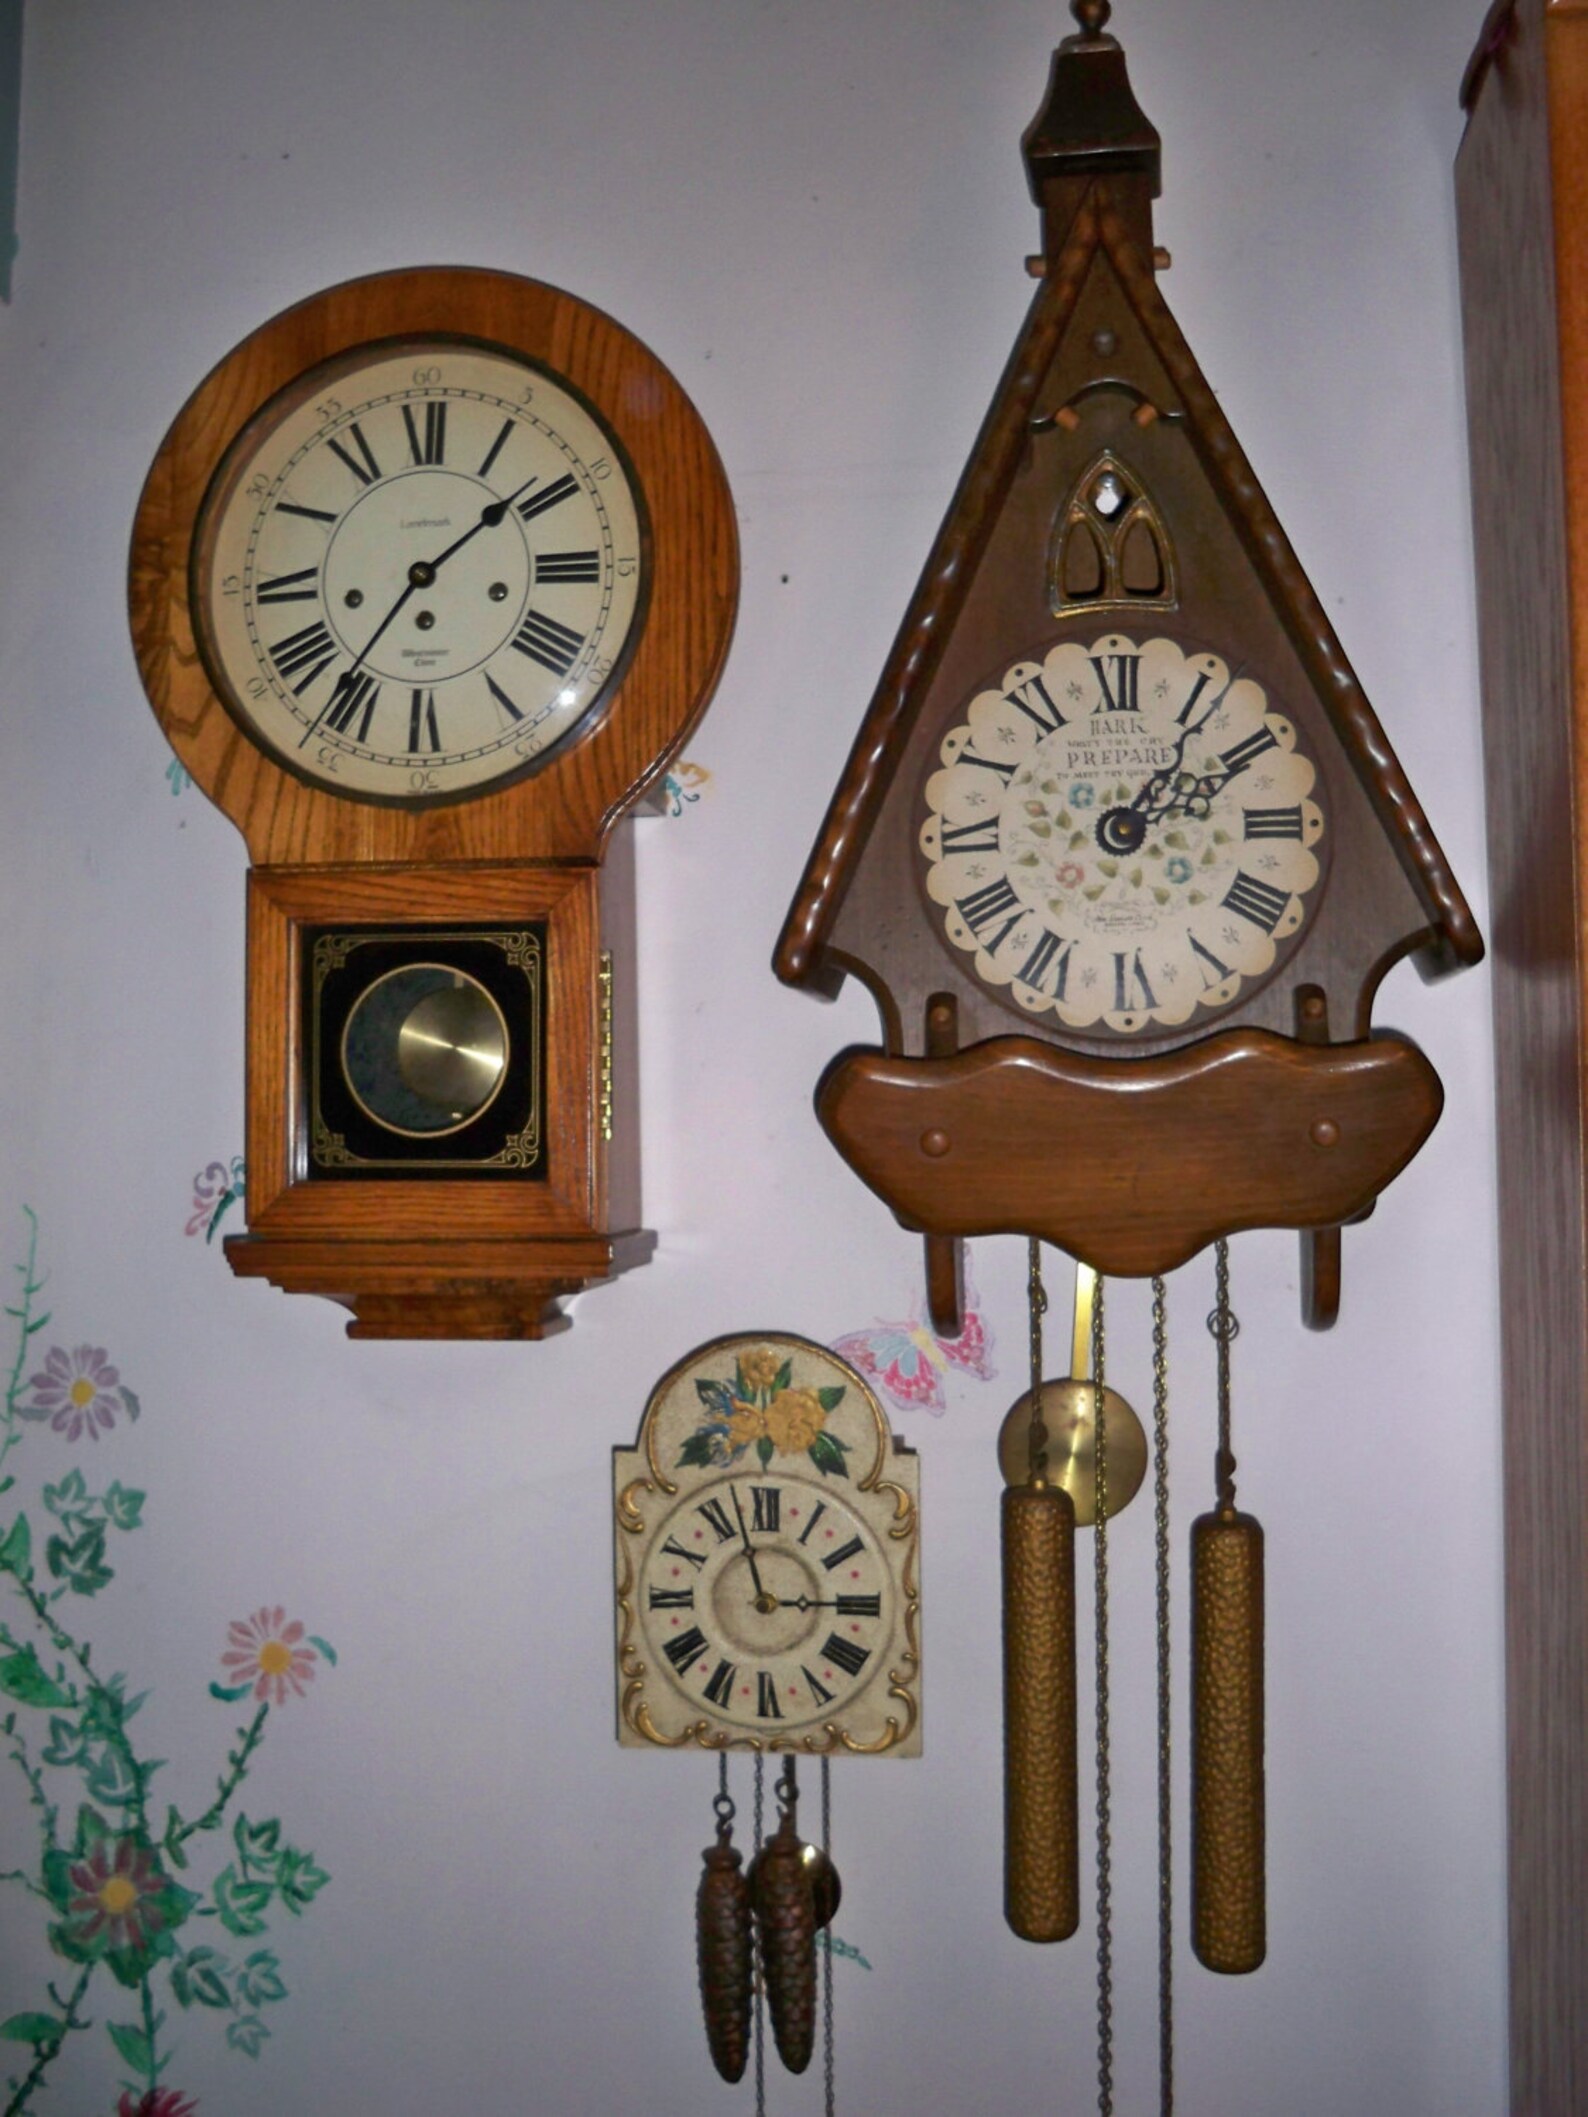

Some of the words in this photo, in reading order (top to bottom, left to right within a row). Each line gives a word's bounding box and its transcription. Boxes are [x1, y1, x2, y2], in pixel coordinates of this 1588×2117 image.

[413, 367, 441, 385] 60
[519, 387, 534, 405] 5
[316, 398, 342, 422] 55
[327, 421, 383, 494] XI
[400, 401, 447, 468] XII
[477, 418, 516, 478] I
[589, 457, 613, 481] 10
[275, 487, 340, 534] X
[517, 472, 581, 522] II
[256, 562, 320, 605] IX
[534, 550, 600, 585] III
[617, 557, 636, 577] 15
[268, 620, 342, 698] VIII
[508, 609, 588, 678] IIII
[587, 656, 613, 685] 20
[1086, 654, 1143, 715] XII
[324, 670, 384, 746] VII
[406, 688, 446, 754] VI
[480, 667, 531, 731] V
[1003, 674, 1071, 746] XI
[1175, 671, 1212, 728] I
[514, 733, 543, 759] 25
[1090, 717, 1148, 736] HARK
[1217, 723, 1282, 776] II
[317, 746, 345, 773] 35
[956, 735, 1022, 790] X
[1067, 747, 1173, 769] PREPARE
[940, 814, 1001, 860] IX
[1242, 803, 1304, 843] III
[954, 875, 1036, 959] VIII
[1221, 870, 1293, 935] IIII
[1015, 928, 1080, 1001] VII
[1113, 947, 1162, 1012] VI
[1186, 927, 1236, 991] V
[695, 1497, 738, 1545] XI
[749, 1486, 781, 1533] XII
[797, 1499, 827, 1546] I
[660, 1534, 709, 1571] X
[821, 1533, 866, 1572] II
[649, 1585, 695, 1612] IX
[835, 1590, 882, 1619] III
[662, 1625, 711, 1679] VIII
[819, 1630, 873, 1678] IIII
[702, 1658, 738, 1711] VII
[757, 1670, 785, 1719] VI
[801, 1664, 837, 1708] V
